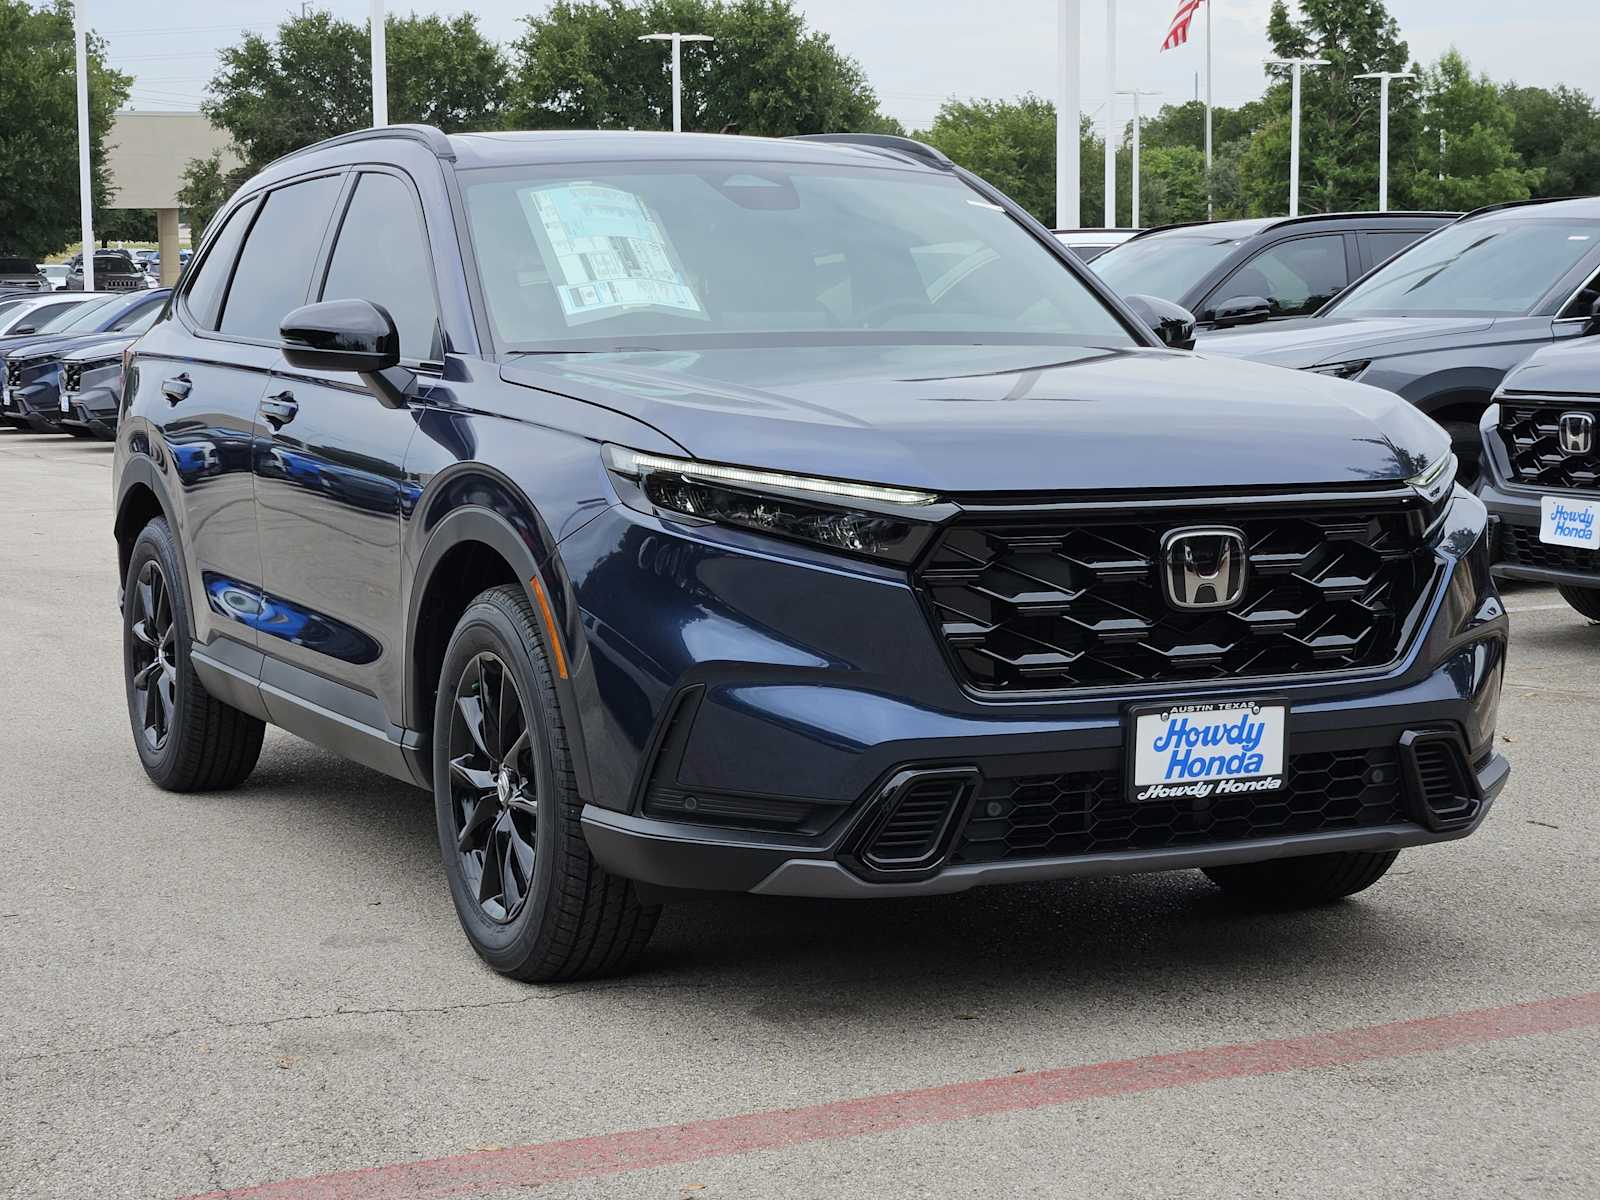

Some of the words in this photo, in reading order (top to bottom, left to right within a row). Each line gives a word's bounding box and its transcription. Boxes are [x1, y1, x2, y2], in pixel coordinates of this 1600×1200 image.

[1551, 504, 1594, 528] Howdy
[1554, 521, 1593, 540] Honda
[1170, 704, 1214, 713] AUSTIN
[1218, 701, 1256, 710] TEXAS
[1153, 714, 1265, 752] Howdy
[1164, 749, 1264, 779] Honda
[1137, 781, 1214, 800] Howdy
[1215, 776, 1282, 794] Honda
